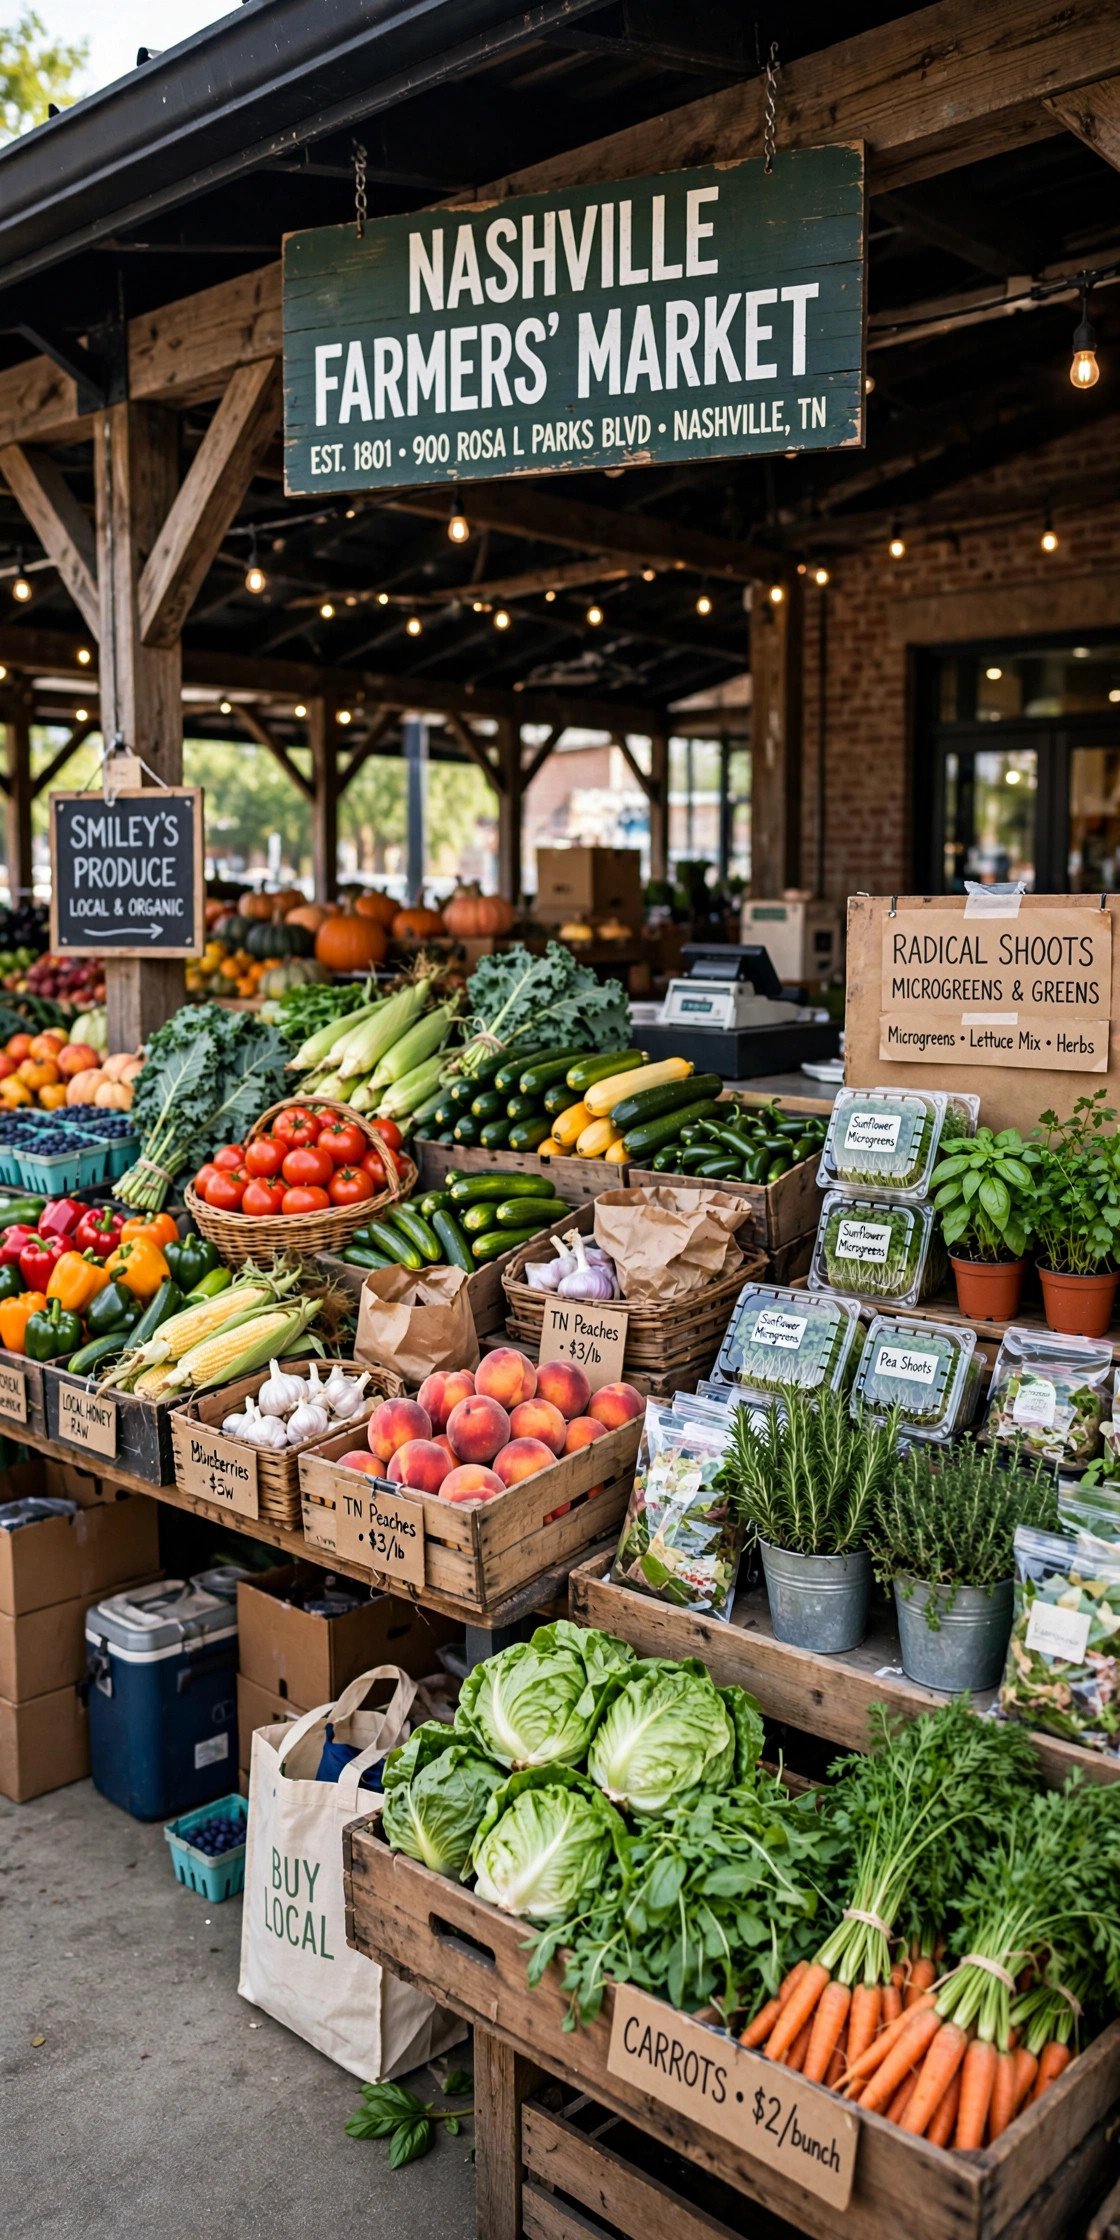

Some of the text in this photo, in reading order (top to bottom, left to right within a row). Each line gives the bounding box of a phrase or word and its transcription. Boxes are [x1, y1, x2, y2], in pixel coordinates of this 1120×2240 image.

[408, 185, 719, 315] NASHVILLE
[577, 282, 820, 400] MARKET
[310, 396, 827, 475] EST. 1801 900 ROSA L PARKS BLVD NASHVILLE, TN
[70, 811, 179, 849] SMILEY'S
[73, 857, 177, 889] PRODUCE
[69, 898, 184, 917] LOCAL & ORGANIC
[893, 933, 1094, 967] RADICAL SHOOTS
[892, 977, 1100, 1005] MICROGREENS & GREENS
[888, 1025, 1095, 1054] Microgreens Lettuce Mix Herbs
[847, 1131, 895, 1149] Microgreens
[851, 1116, 895, 1131] Sunflower
[842, 1223, 886, 1241] Sunflower
[550, 1310, 619, 1342] TN Peaches
[569, 1339, 602, 1365] $3/lb
[879, 1351, 932, 1375] Pea Shoots
[62, 1392, 112, 1428] LOCAL HONEY
[70, 1417, 89, 1440] RAW
[343, 1496, 416, 1538] TN Peaches
[368, 1527, 405, 1561] $3/lb
[272, 1846, 320, 1903] BUY
[264, 1886, 335, 1960] LOCAL
[623, 2016, 841, 2173] CARROTS $2/bunch
